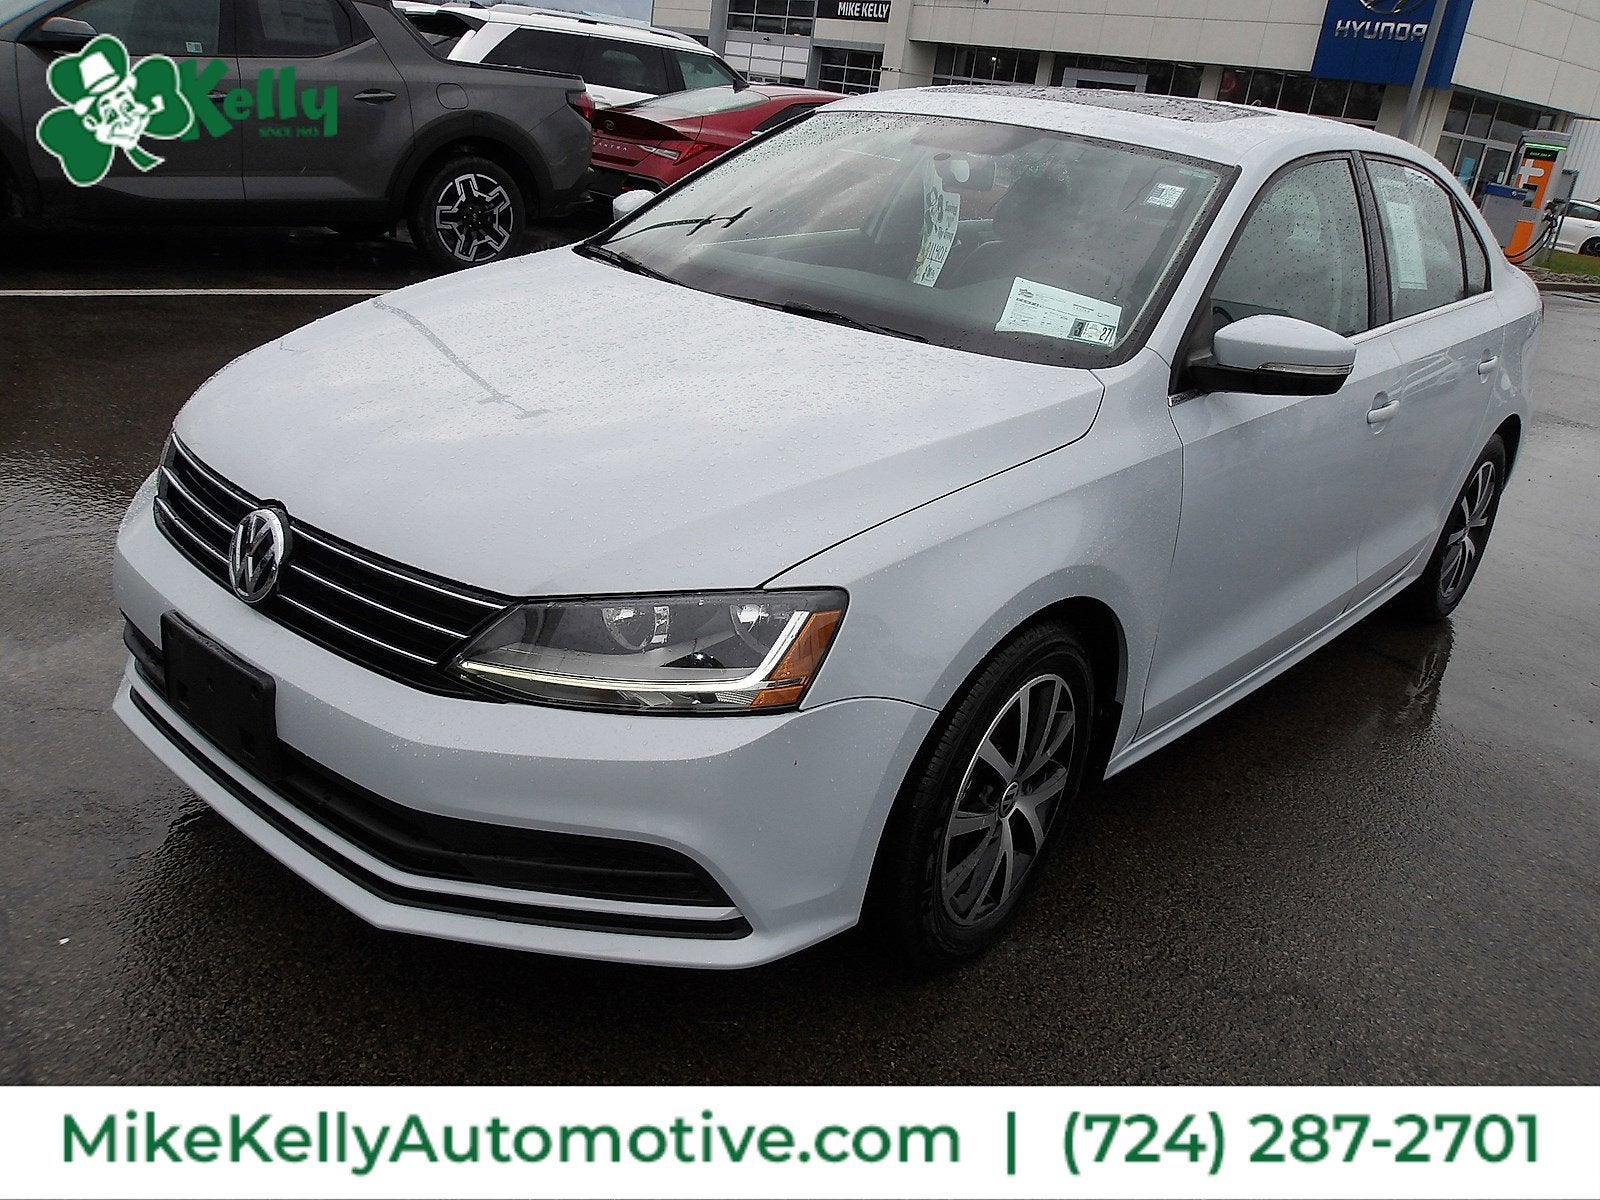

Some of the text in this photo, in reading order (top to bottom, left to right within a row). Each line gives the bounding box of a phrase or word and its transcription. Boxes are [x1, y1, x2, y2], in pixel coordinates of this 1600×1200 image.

[837, 1, 890, 19] MIKE KELLY
[1334, 19, 1429, 42] HYUNDA
[1099, 326, 1112, 342] 27
